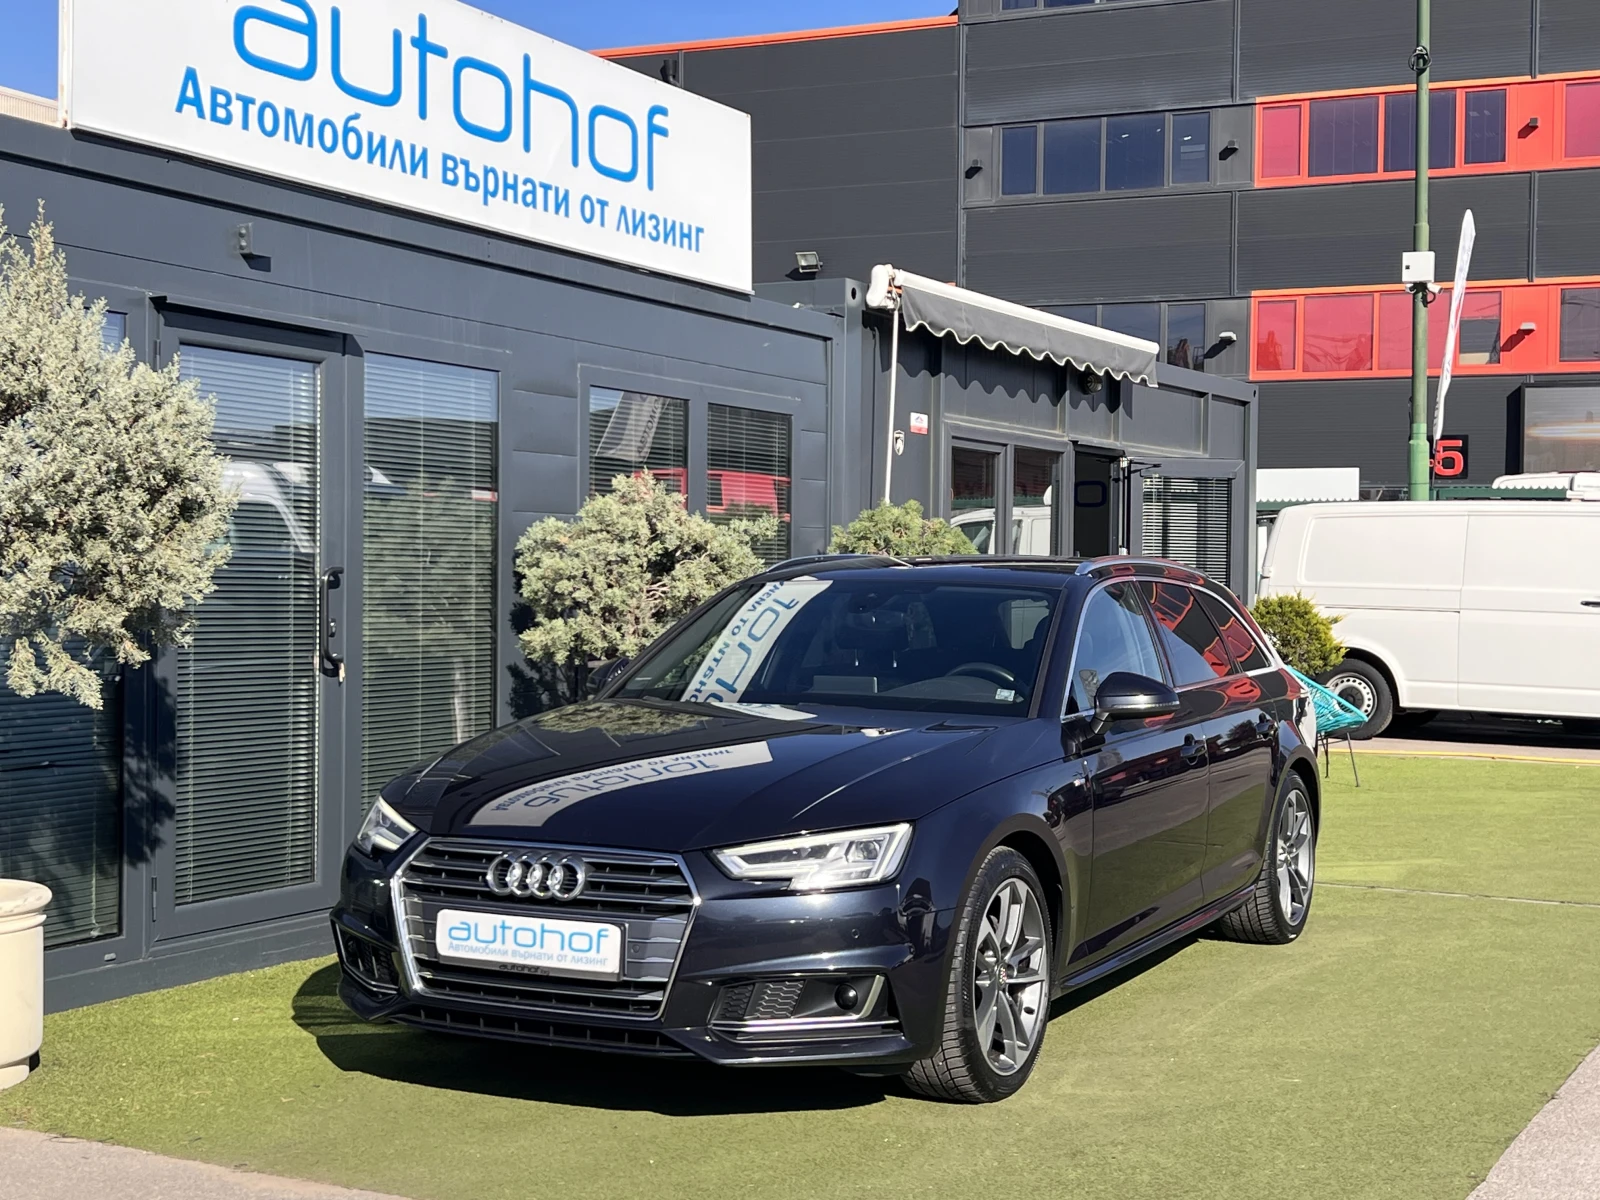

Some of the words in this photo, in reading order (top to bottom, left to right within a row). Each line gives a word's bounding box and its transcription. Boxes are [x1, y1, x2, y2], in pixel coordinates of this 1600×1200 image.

[233, 0, 669, 191] autohof
[175, 66, 428, 179] Автомобили
[442, 152, 569, 218] върнати
[580, 194, 609, 227] от
[616, 204, 704, 253] лизинг
[448, 920, 609, 954] autohof
[448, 942, 509, 957] Автомобили
[511, 948, 553, 962] върнати
[557, 953, 568, 963] от
[570, 956, 608, 967] лизинг
